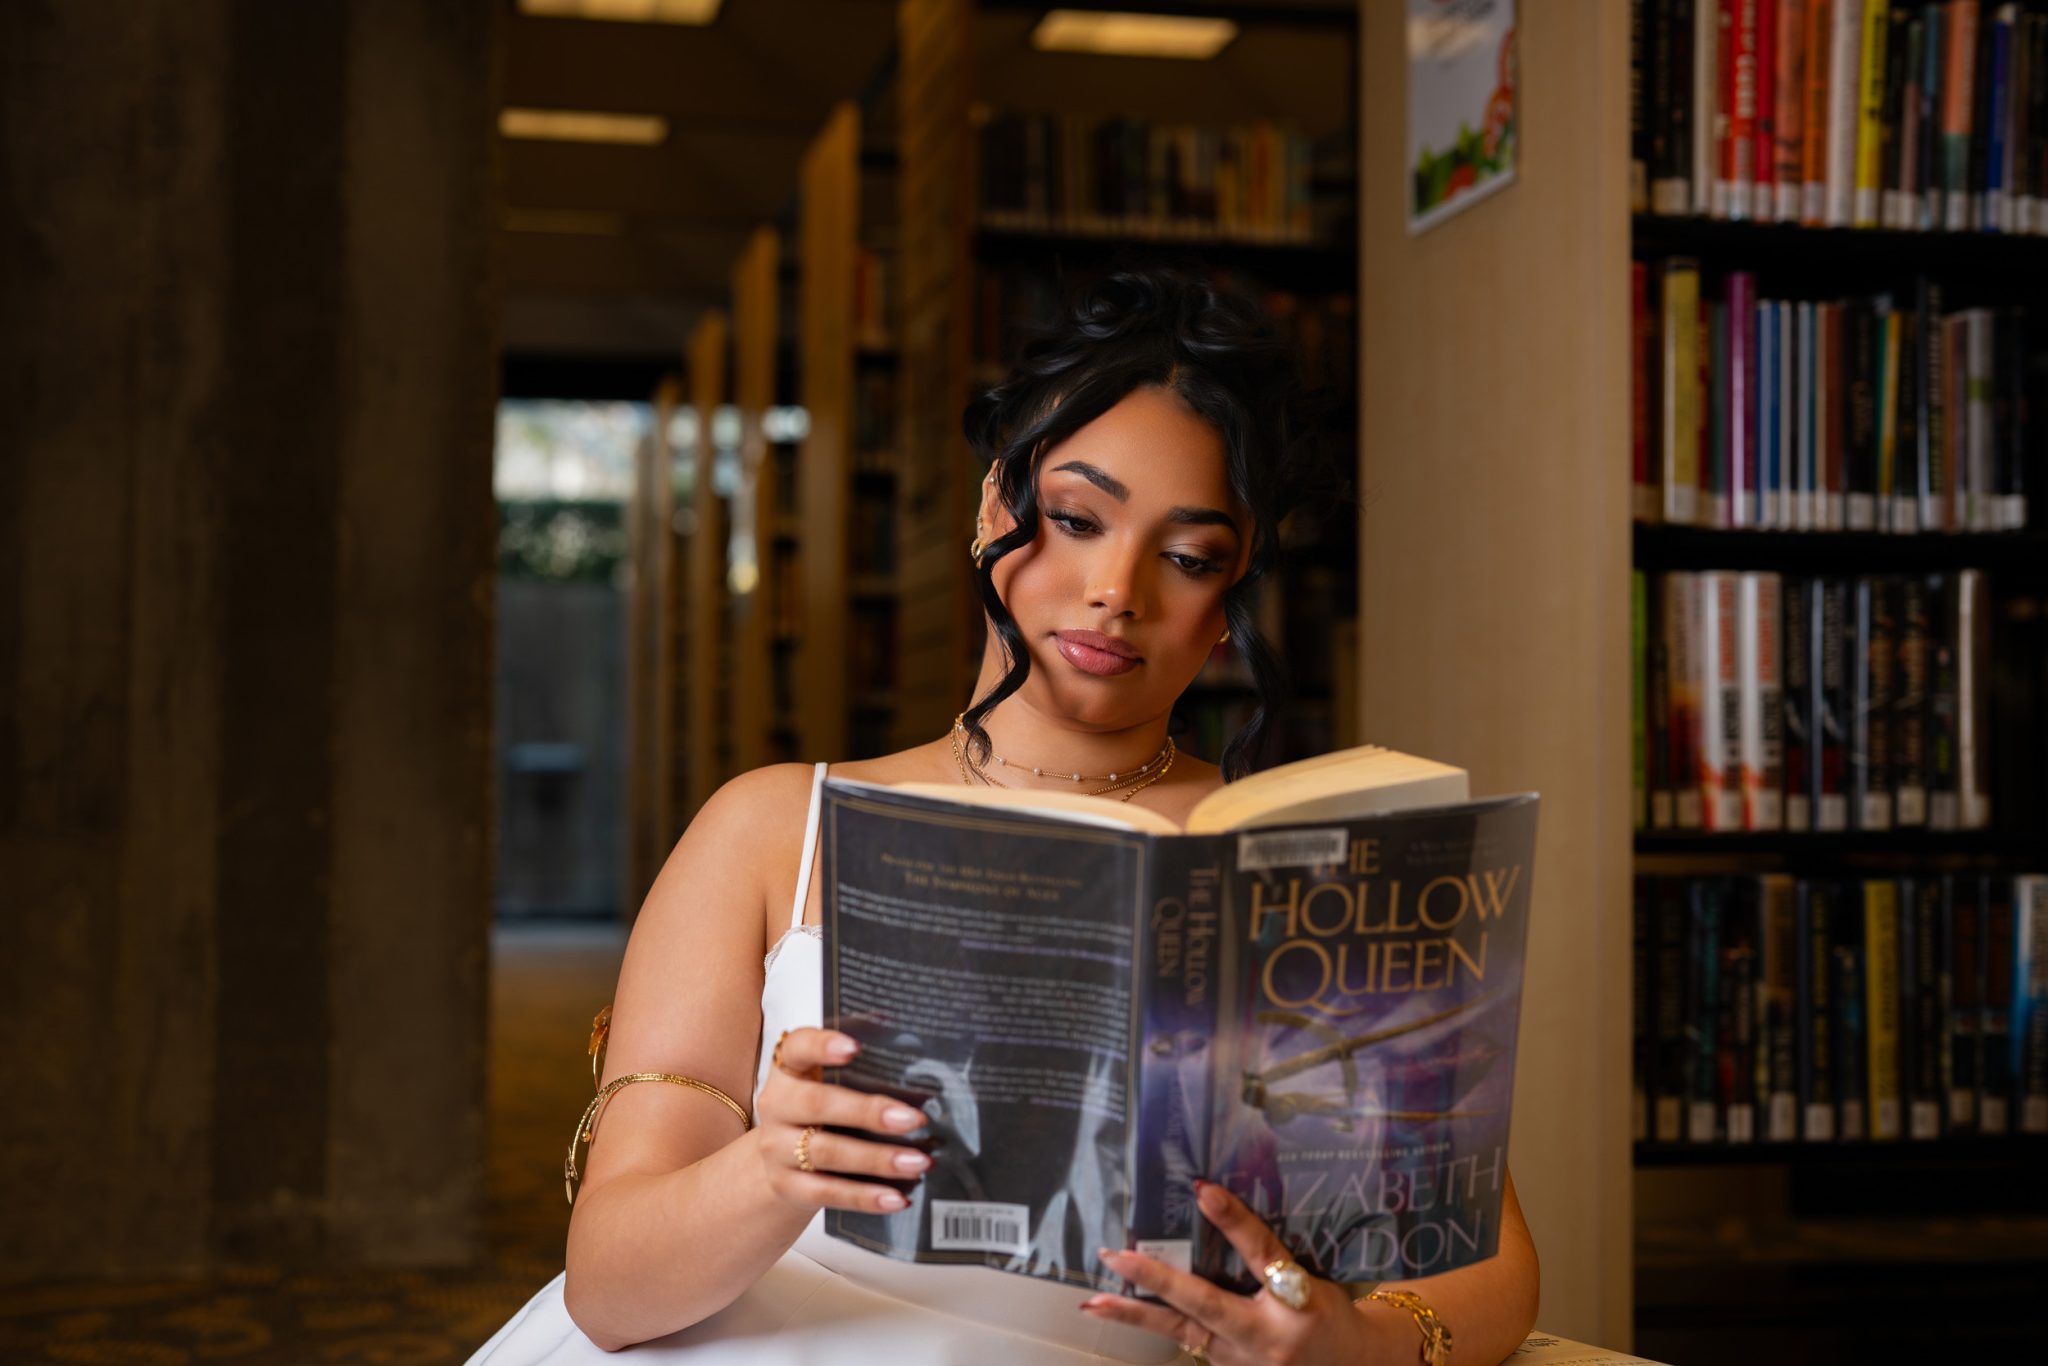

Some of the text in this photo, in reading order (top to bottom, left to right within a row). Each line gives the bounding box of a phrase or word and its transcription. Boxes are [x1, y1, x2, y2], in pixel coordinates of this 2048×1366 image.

[1151, 896, 1187, 978] QUEEN
[1249, 865, 1521, 941] HOLLOW
[1262, 931, 1489, 1016] QUEEN
[1274, 1207, 1482, 1273] AYDON
